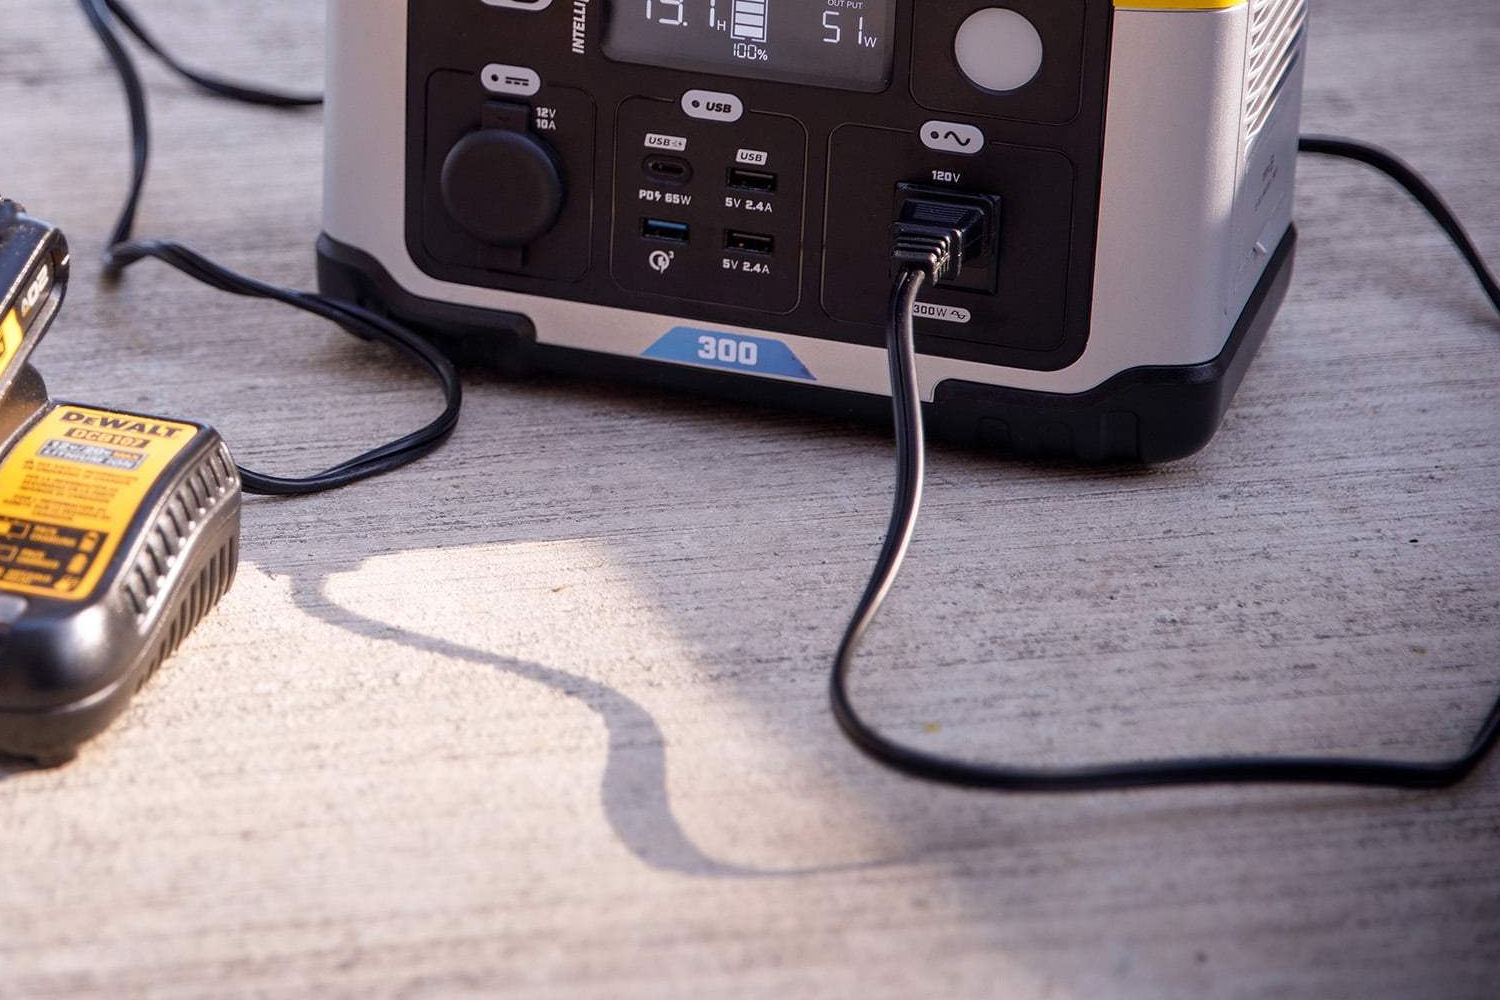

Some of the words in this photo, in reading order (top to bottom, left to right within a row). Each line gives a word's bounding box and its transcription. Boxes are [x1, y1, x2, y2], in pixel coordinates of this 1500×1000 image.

[572, 1, 587, 54] INTELLI
[733, 43, 768, 61] 100%
[536, 107, 557, 119] 12V
[705, 101, 732, 114] USB
[536, 118, 557, 131] 10A
[740, 151, 763, 163] USB
[931, 170, 962, 184] 120V
[664, 192, 692, 206] 65W
[725, 197, 741, 209] 5V
[745, 200, 773, 213] 2.4A
[722, 258, 739, 270] 5V
[742, 261, 770, 274] 2.4A
[913, 304, 948, 318] 300W
[697, 335, 758, 366] 300
[69, 428, 145, 448] DCB107
